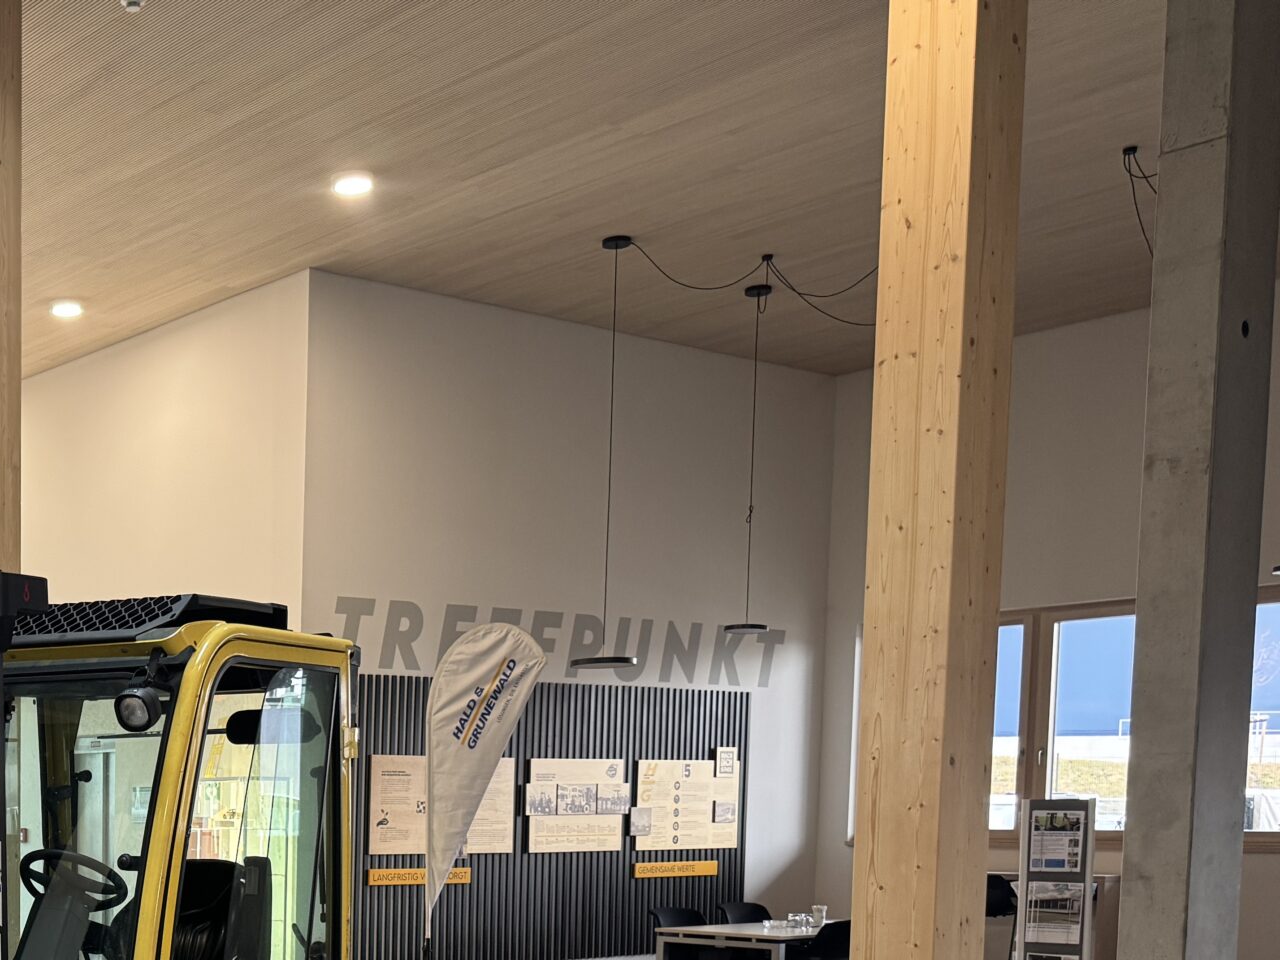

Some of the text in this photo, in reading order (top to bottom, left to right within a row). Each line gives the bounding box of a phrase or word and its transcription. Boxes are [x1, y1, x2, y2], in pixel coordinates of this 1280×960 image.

[334, 596, 786, 688] TREFPUNKT
[453, 686, 484, 740] HALD &
[467, 659, 516, 749] GRUNEWALD
[683, 763, 691, 778] 5
[372, 871, 468, 882] LANGFRISTIG VORGT
[638, 864, 696, 874] GEMEINSAME WERTE
